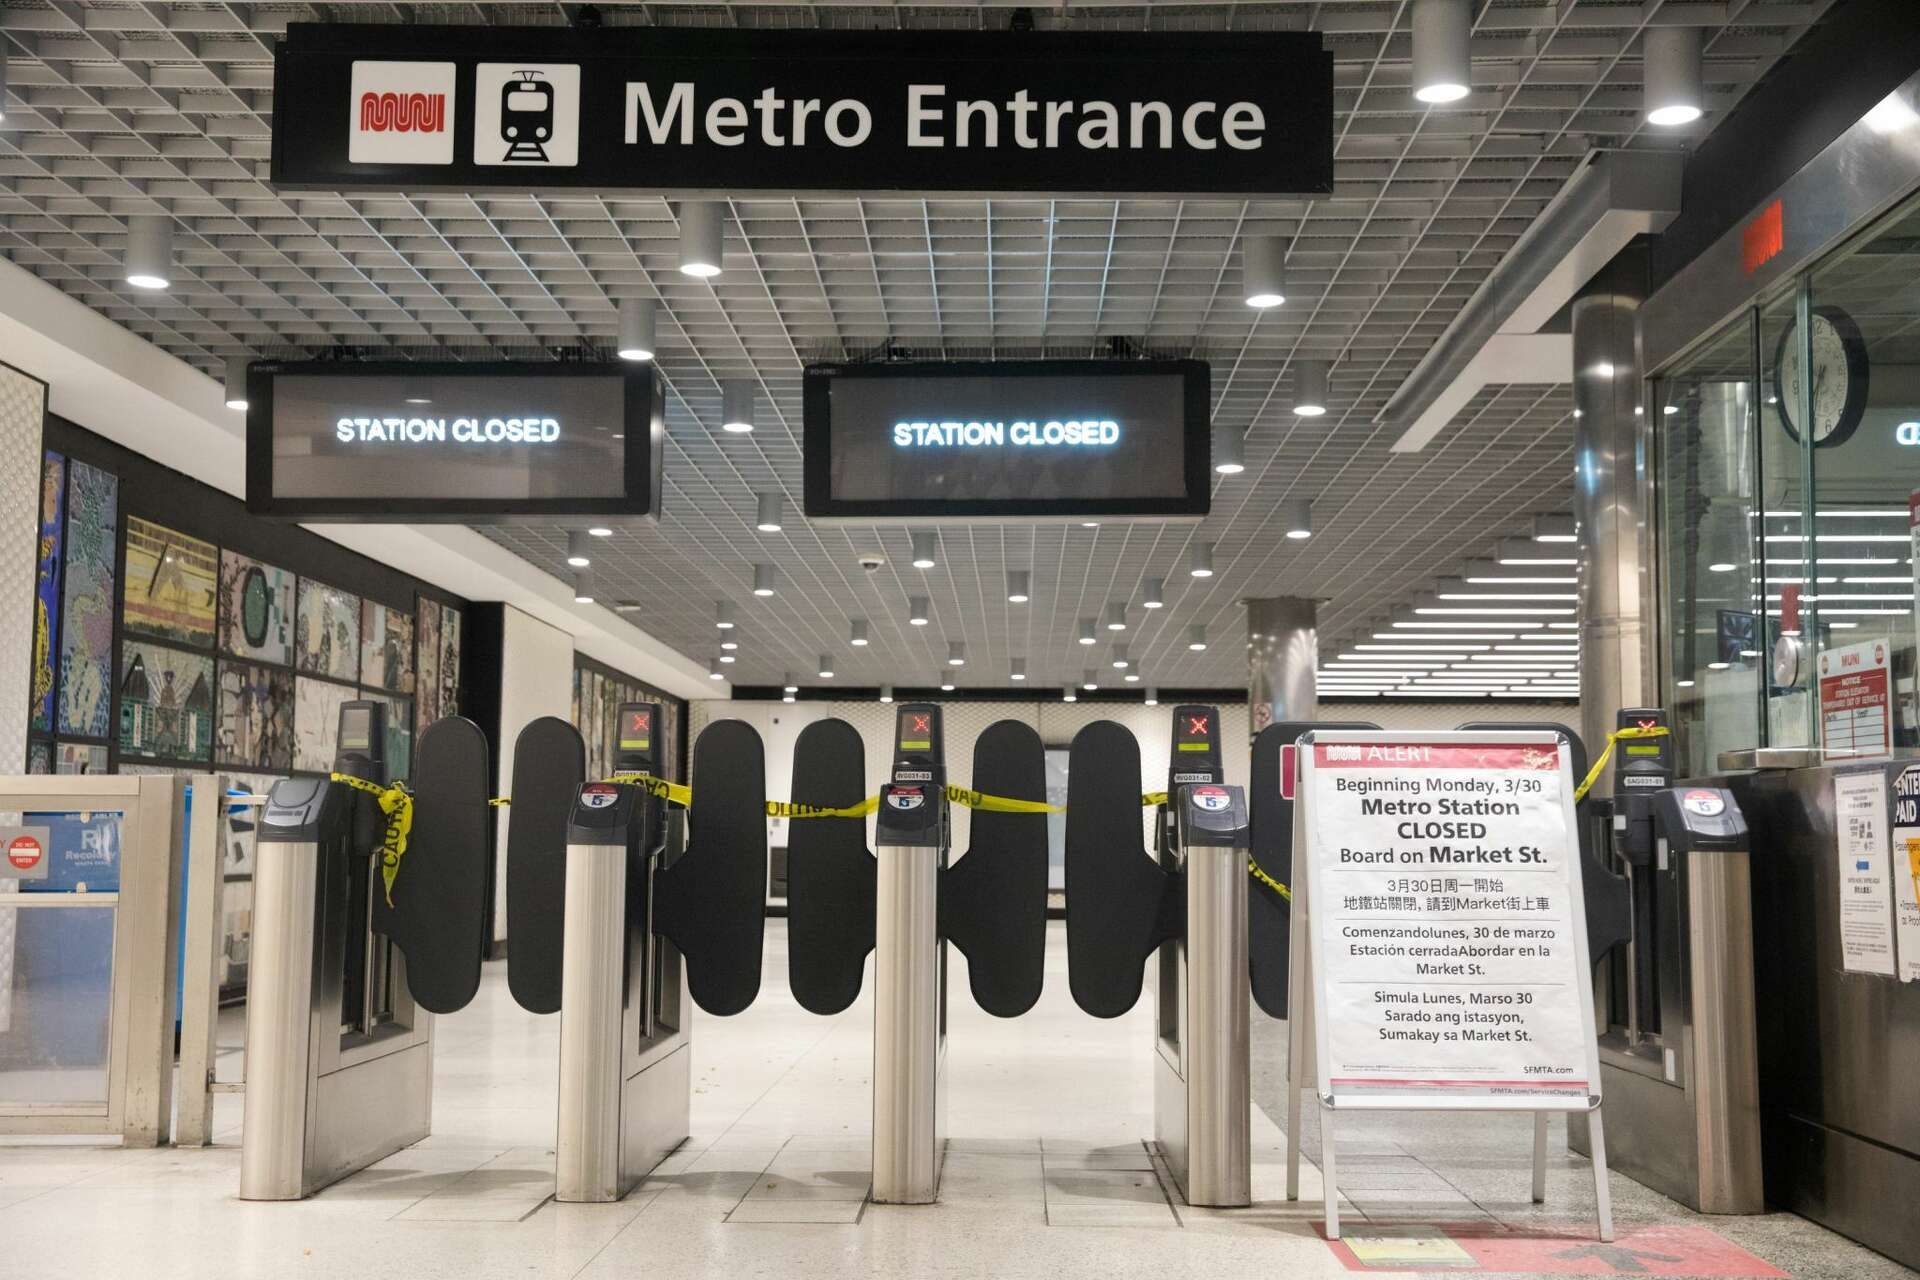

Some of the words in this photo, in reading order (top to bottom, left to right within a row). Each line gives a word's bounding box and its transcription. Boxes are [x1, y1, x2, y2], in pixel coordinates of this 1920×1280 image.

[625, 82, 871, 147] Metro
[908, 85, 1265, 149] Entrance
[337, 418, 445, 443] STATION
[453, 418, 560, 443] CLOSED
[894, 422, 1003, 446] STATION
[1010, 421, 1119, 445] CLOSED
[1368, 746, 1430, 761] ALERT
[1337, 777, 1420, 795] Beginning
[1426, 778, 1499, 795] Monday,
[1505, 779, 1541, 795] 3/30
[1362, 799, 1431, 815] Metro
[1438, 799, 1519, 815] Station
[1398, 822, 1486, 839] CLOSED
[1341, 848, 1393, 863] Board
[1400, 852, 1423, 863] on
[1430, 846, 1512, 863] Market
[1519, 847, 1547, 863] St.
[1343, 927, 1469, 940] Comenzandolunes,
[1474, 927, 1489, 938] 30
[1494, 927, 1509, 938] de
[1514, 930, 1555, 938] marzo
[1351, 944, 1404, 955] Estación
[1409, 945, 1515, 957] cerradaAbordar
[1519, 948, 1535, 956] en
[1539, 945, 1549, 956] la
[1417, 963, 1464, 974] Market
[1468, 964, 1485, 975] St.
[1375, 991, 1418, 1003] Simula
[1423, 993, 1465, 1005] Lunes,
[1470, 993, 1512, 1004] Marso
[1517, 993, 1532, 1004] 30
[1385, 1010, 1431, 1022] Sarado
[1435, 1014, 1460, 1025] ang
[1465, 1011, 1524, 1025] istasyon,
[1380, 1028, 1439, 1043] Sumakay
[1444, 1032, 1457, 1040] sa
[1462, 1030, 1511, 1041] Market
[1515, 1030, 1532, 1041] St.
